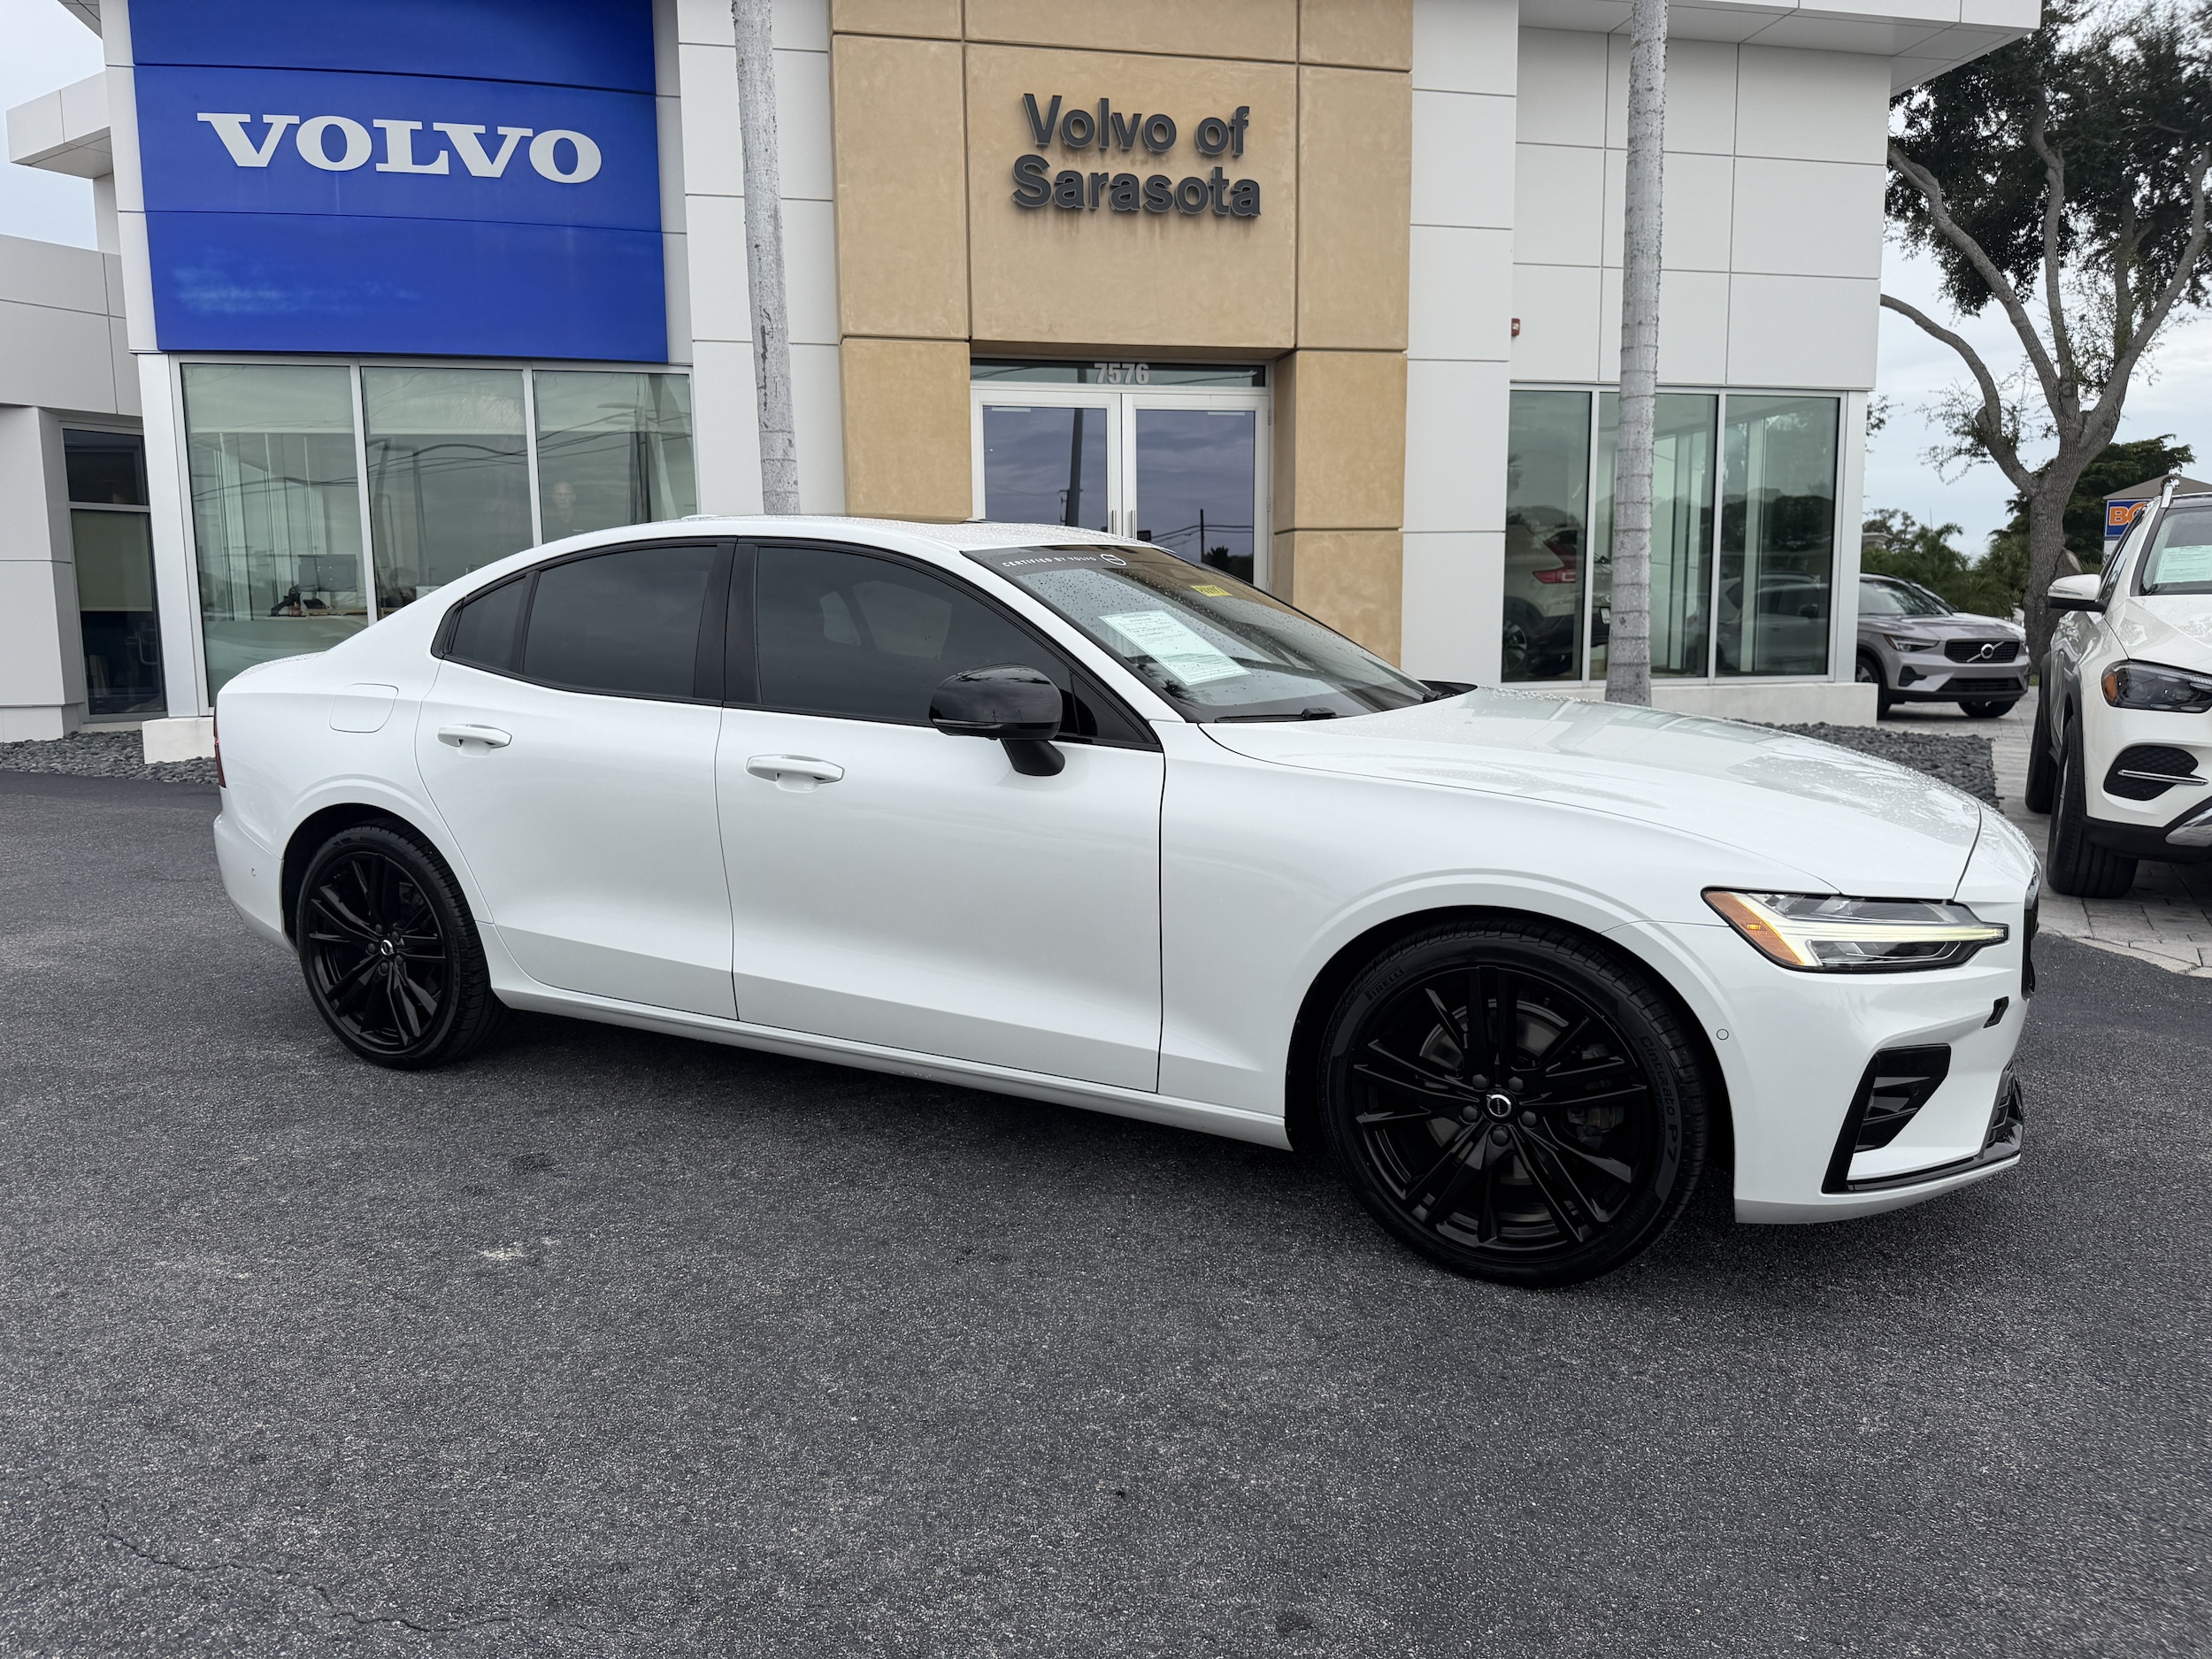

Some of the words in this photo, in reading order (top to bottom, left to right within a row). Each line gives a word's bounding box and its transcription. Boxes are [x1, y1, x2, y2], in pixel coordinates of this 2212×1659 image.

[197, 112, 603, 184] VOLVO
[1023, 93, 1178, 153] Volvo
[1194, 105, 1250, 157] of
[1011, 154, 1262, 218] Sarasota
[1094, 362, 1150, 385] 7576
[1002, 557, 1053, 567] CERTIFIED
[1668, 1124, 1678, 1165] P7
